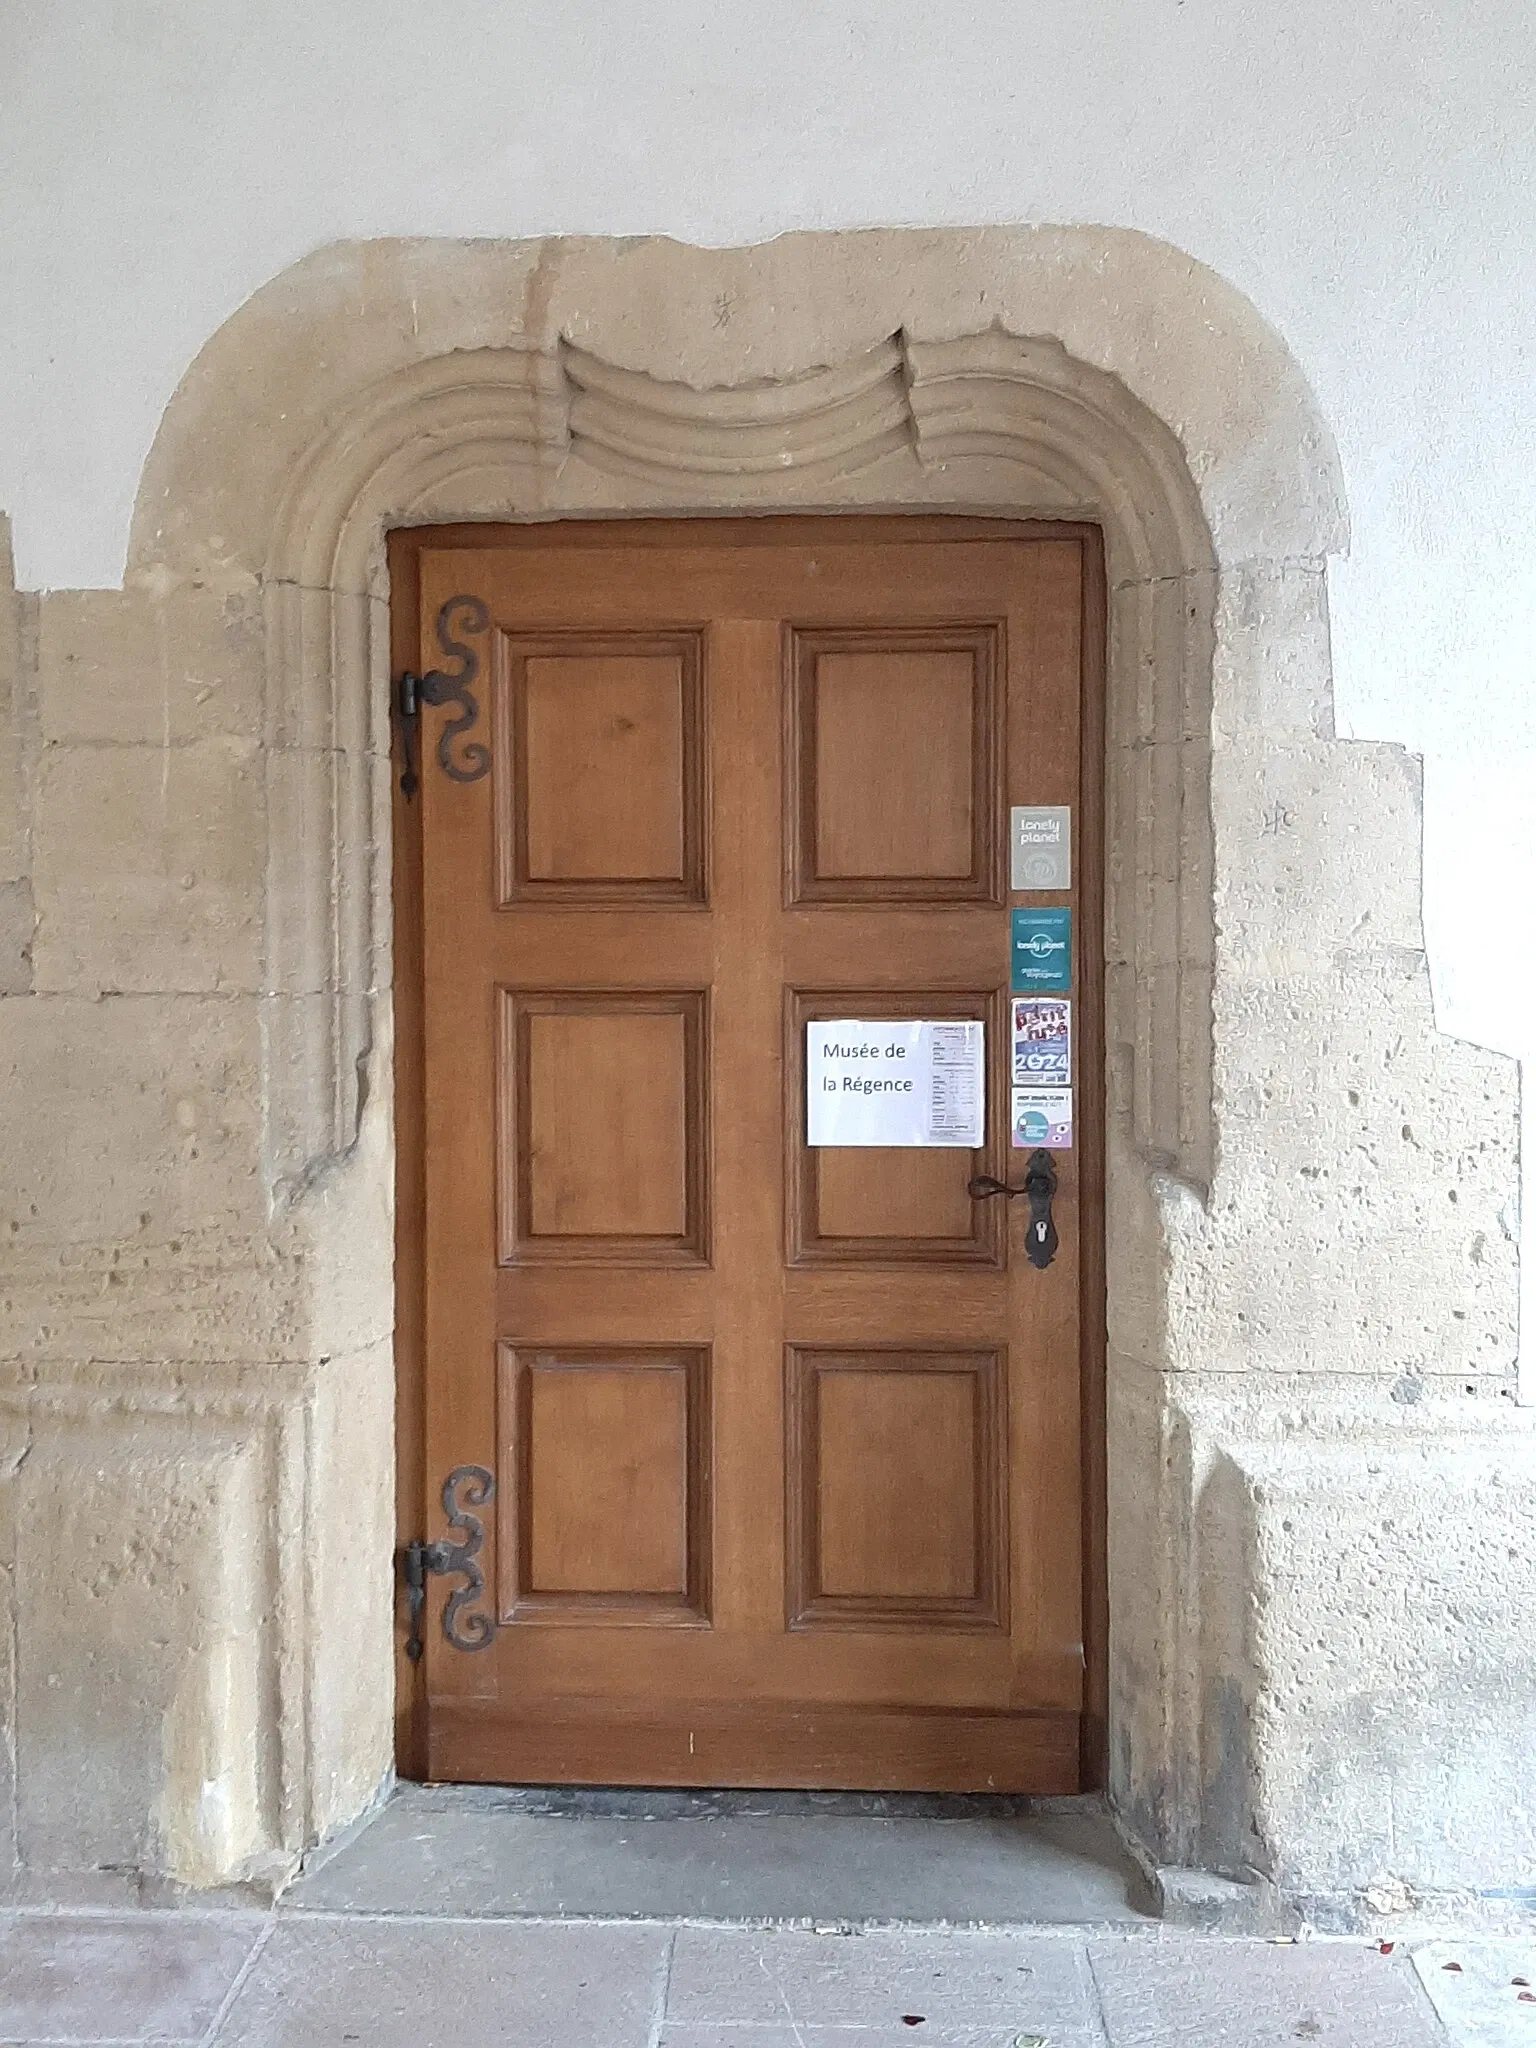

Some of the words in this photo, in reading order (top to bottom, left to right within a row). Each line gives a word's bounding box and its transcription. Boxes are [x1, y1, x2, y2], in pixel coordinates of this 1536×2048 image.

[1020, 819, 1061, 833] lonely
[1020, 832, 1061, 846] planet
[823, 1043, 880, 1058] Musée
[885, 1043, 906, 1058] de
[1016, 1053, 1068, 1071] 2024
[823, 1076, 837, 1092] la
[843, 1076, 913, 1095] Régence
